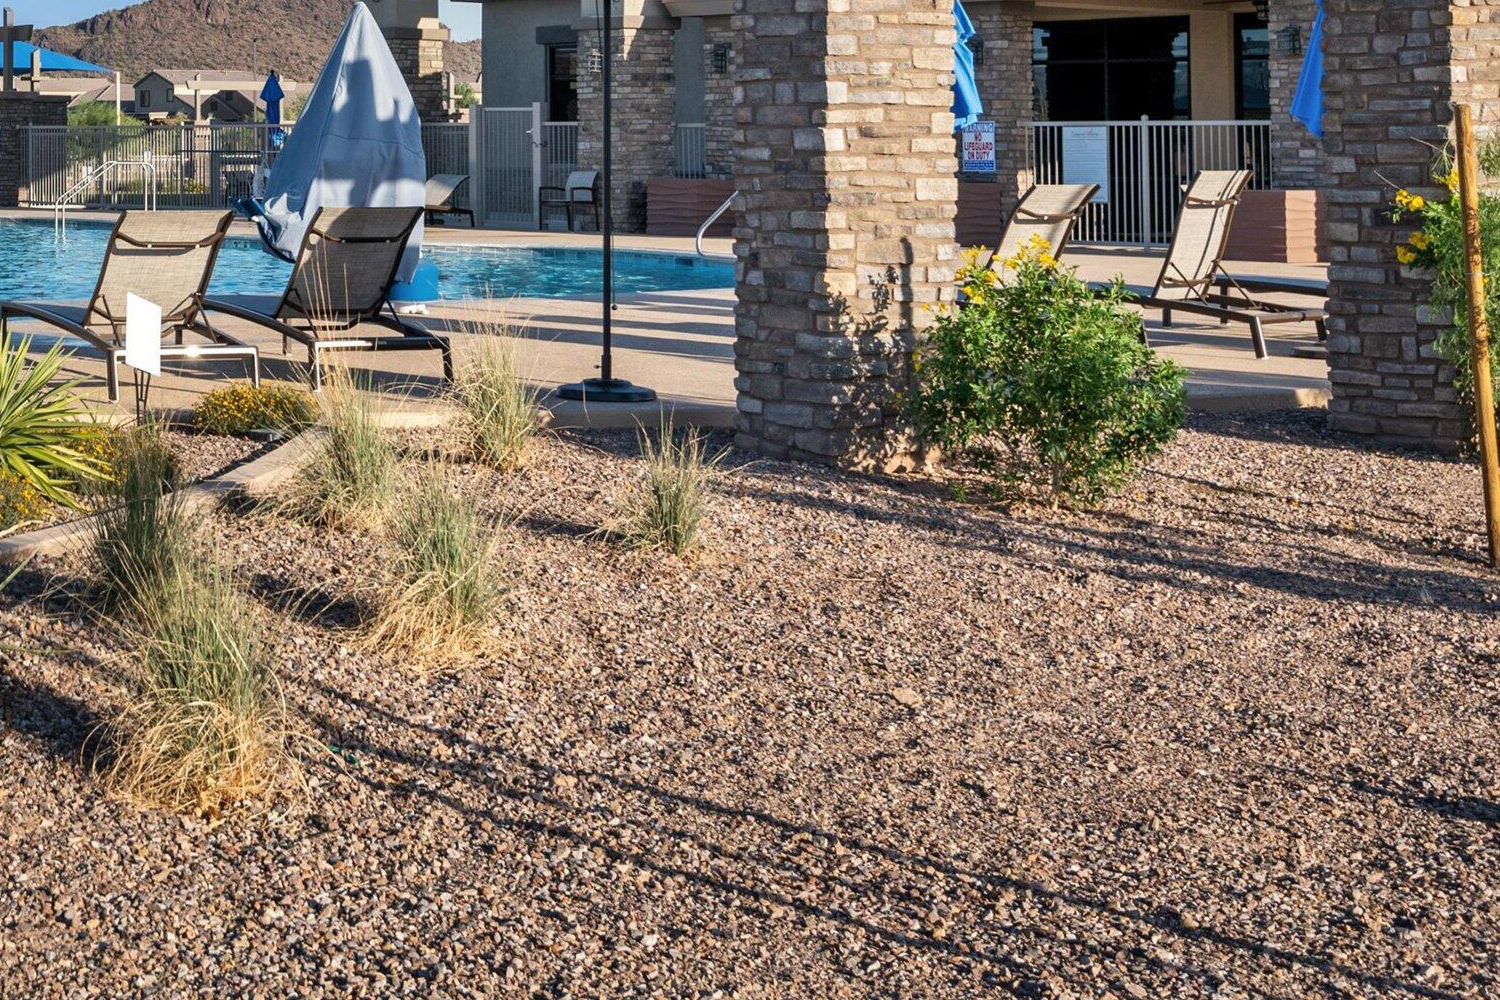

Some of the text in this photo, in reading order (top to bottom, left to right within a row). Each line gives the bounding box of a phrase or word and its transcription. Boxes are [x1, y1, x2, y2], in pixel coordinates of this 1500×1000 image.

[974, 133, 982, 141] NO
[964, 142, 993, 151] LIFEGUARD
[968, 151, 990, 160] ON DUTY
